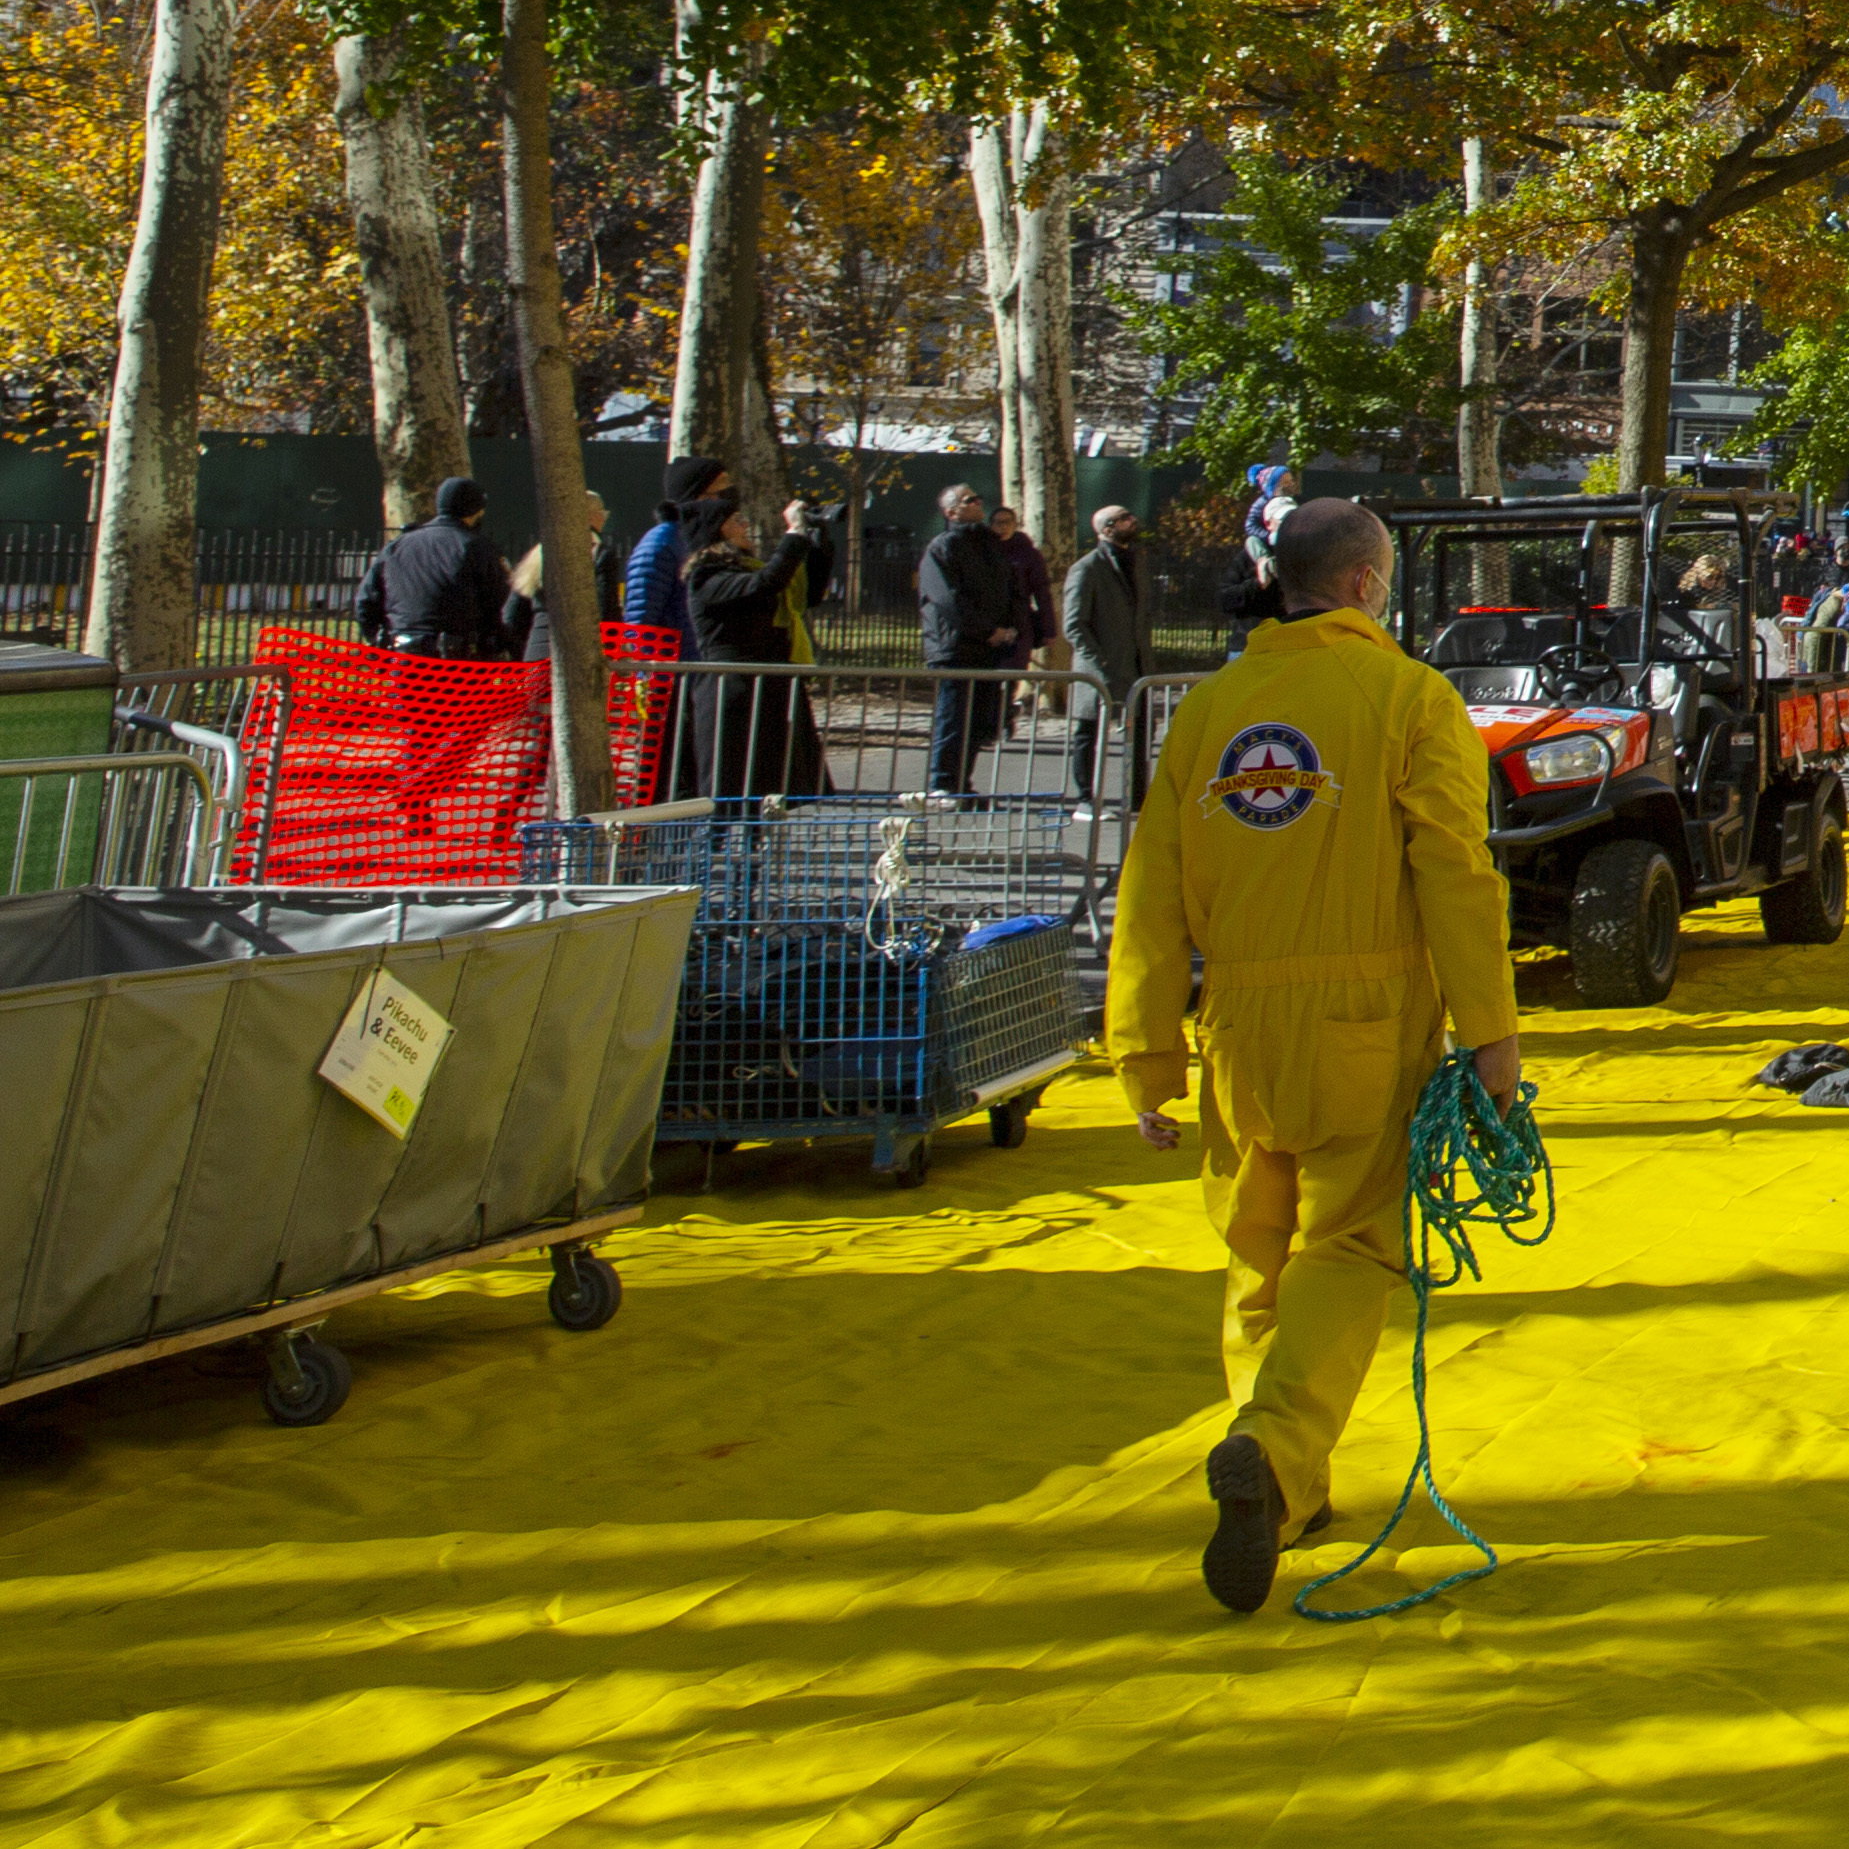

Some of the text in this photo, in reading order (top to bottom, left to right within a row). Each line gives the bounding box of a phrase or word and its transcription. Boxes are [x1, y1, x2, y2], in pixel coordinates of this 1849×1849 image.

[1233, 729, 1303, 754] MACY'S
[1210, 771, 1327, 797] THANKSGIVING DAY
[1238, 803, 1300, 822] PARADE
[381, 996, 428, 1043] Pikachu
[370, 1017, 383, 1038] &
[383, 1026, 418, 1065] Eevee
